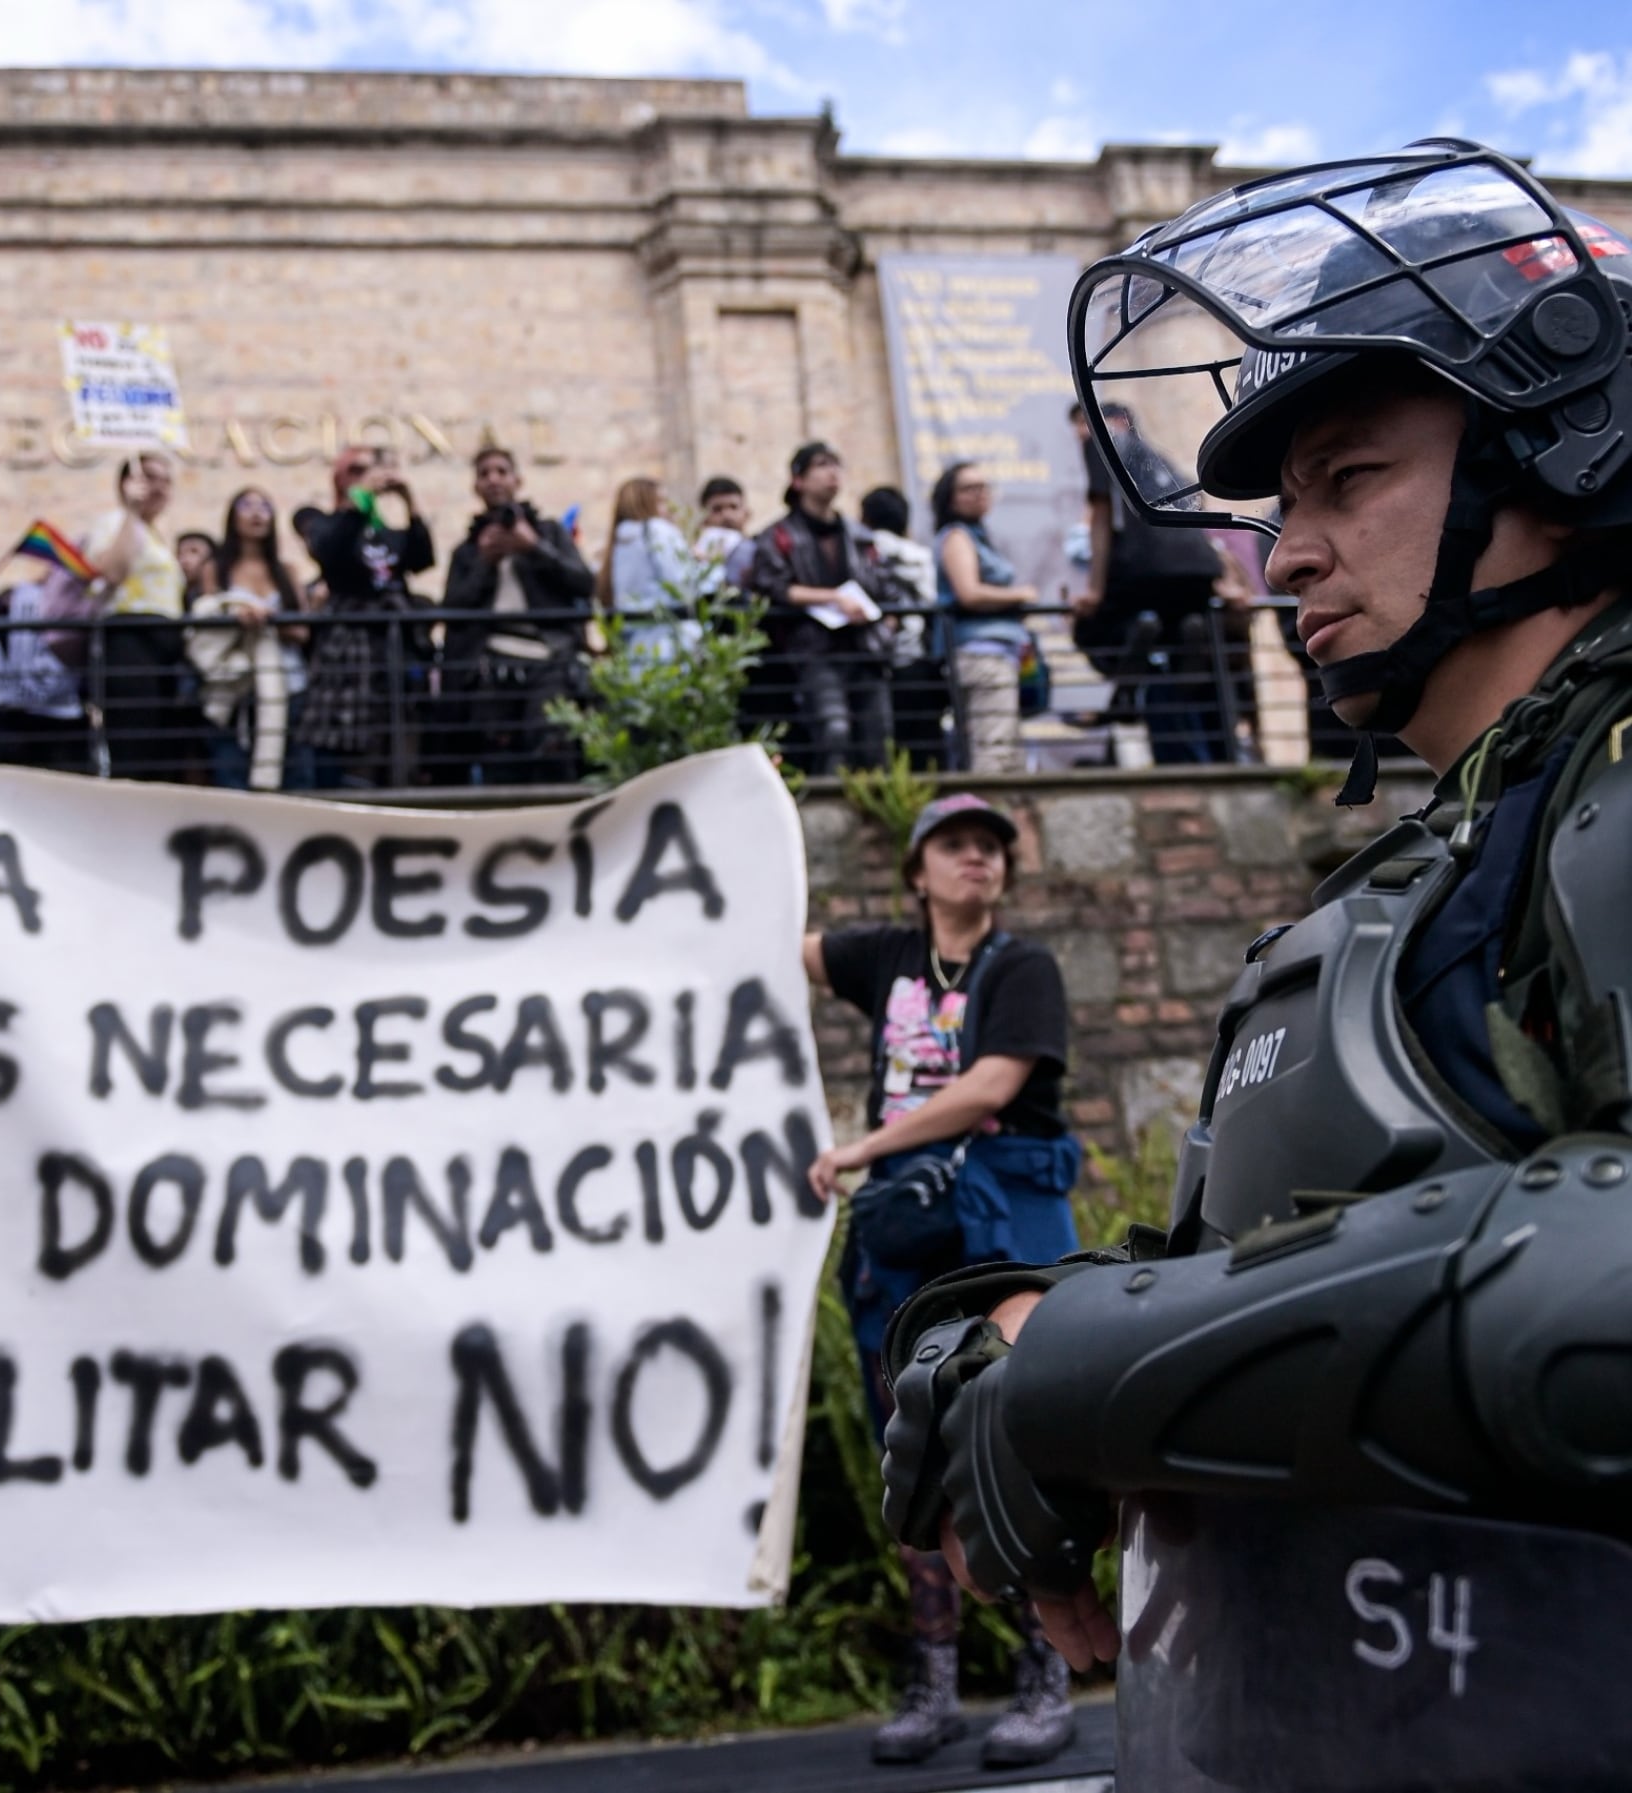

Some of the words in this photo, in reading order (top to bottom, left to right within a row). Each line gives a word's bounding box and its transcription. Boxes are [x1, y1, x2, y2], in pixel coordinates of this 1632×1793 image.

[166, 799, 726, 946] POESÍA
[87, 977, 807, 1111] NECESARIA
[35, 1107, 827, 1282] DOMINACIÓN
[450, 1280, 780, 1536] NO!
[1344, 1557, 1479, 1697] S4
